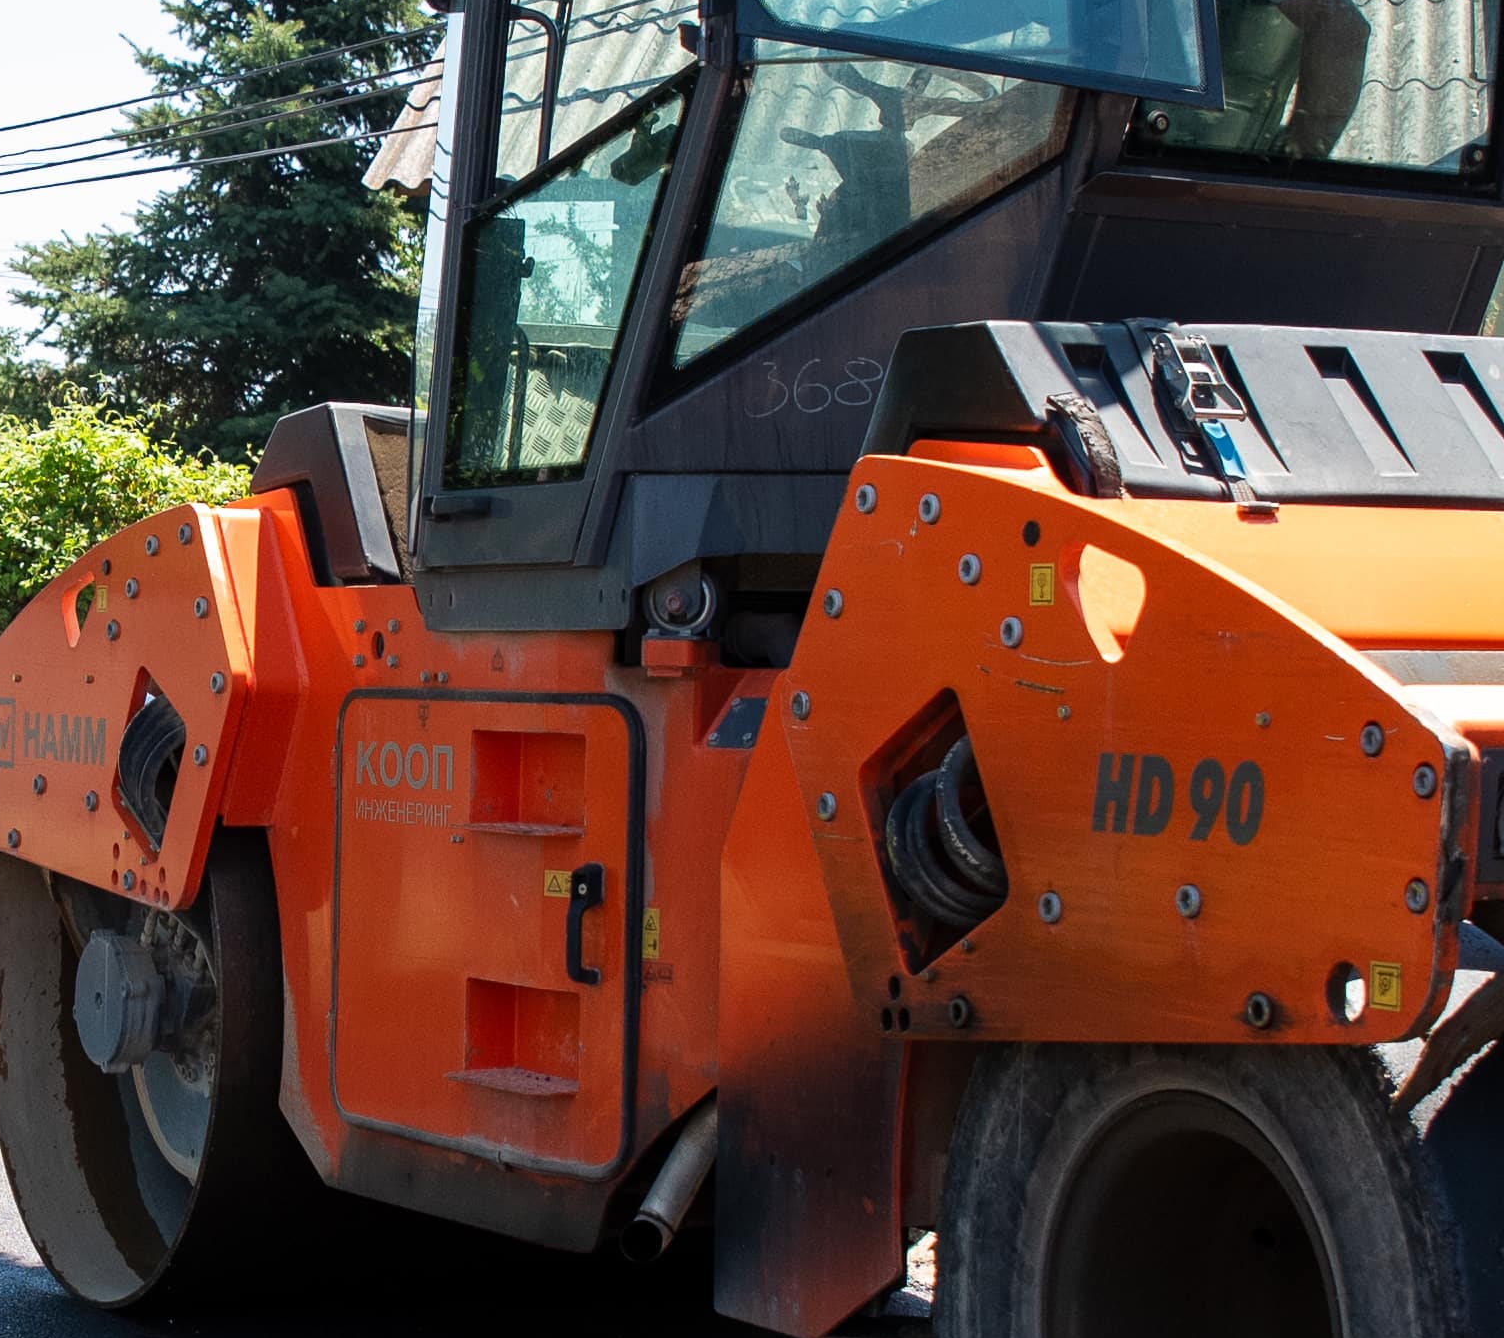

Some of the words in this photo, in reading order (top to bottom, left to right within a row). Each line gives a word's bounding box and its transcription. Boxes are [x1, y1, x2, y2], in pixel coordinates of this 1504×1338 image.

[23, 711, 106, 766] HAMM
[356, 740, 454, 791] КООП
[355, 797, 453, 828] ИНЖЕНЕРИНГ
[1092, 752, 1175, 836] HD
[1188, 757, 1264, 846] 90
